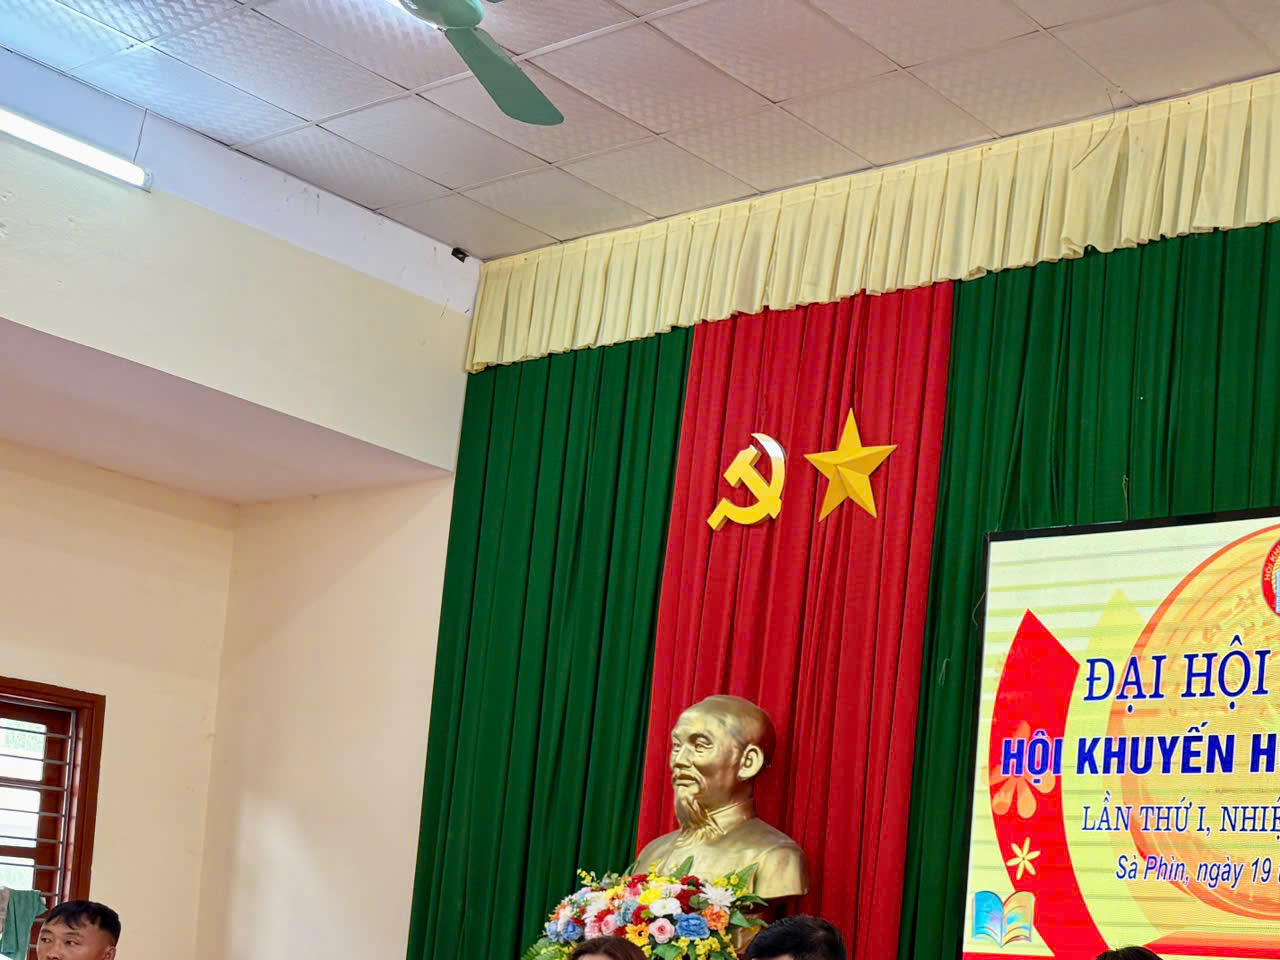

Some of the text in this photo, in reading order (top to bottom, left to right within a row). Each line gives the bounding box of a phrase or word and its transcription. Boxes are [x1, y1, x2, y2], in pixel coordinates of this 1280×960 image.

[1083, 654, 1168, 713] ĐẠI
[1180, 634, 1272, 710] HỘI
[1002, 730, 1064, 784] HỘI
[1076, 721, 1235, 775] KHUYẾN
[1081, 790, 1133, 832] LẦN
[1139, 796, 1193, 832] THỨ
[1196, 806, 1211, 836] I,
[1115, 854, 1138, 880] Sà
[1143, 855, 1190, 886] Phìn,
[1195, 856, 1244, 889] ngày
[1250, 857, 1272, 882] 19
